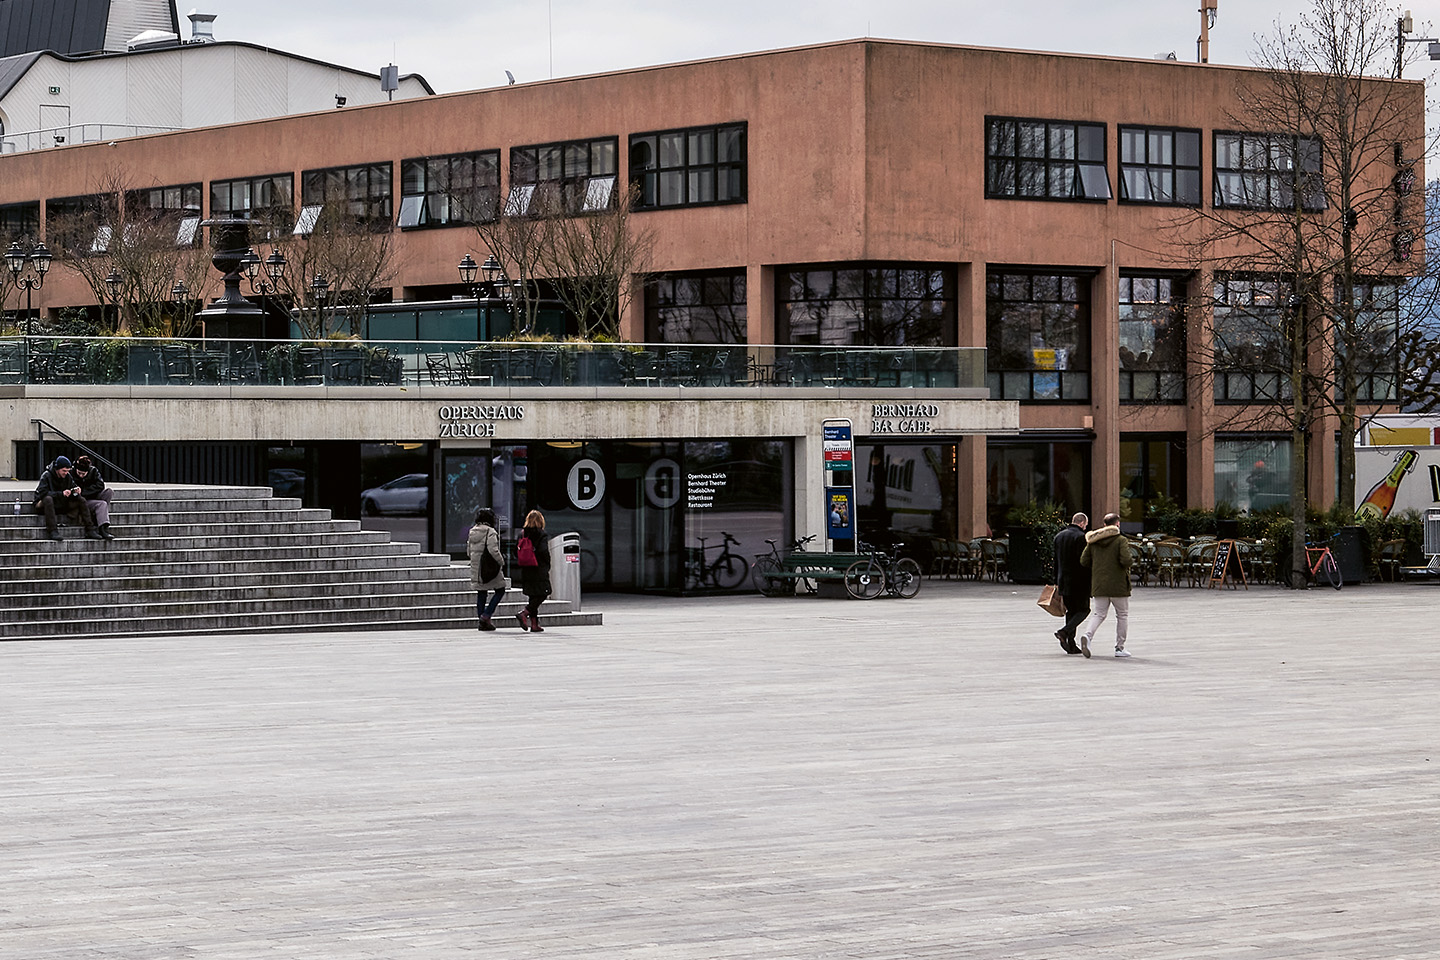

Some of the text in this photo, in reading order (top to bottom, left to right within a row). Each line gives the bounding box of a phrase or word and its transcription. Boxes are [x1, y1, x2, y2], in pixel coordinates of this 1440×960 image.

[440, 405, 525, 420] OPERNHAUS
[872, 404, 940, 417] BERNHARD
[440, 420, 497, 437] ZÜRICH
[872, 419, 895, 433] BAR
[577, 467, 597, 501] B
